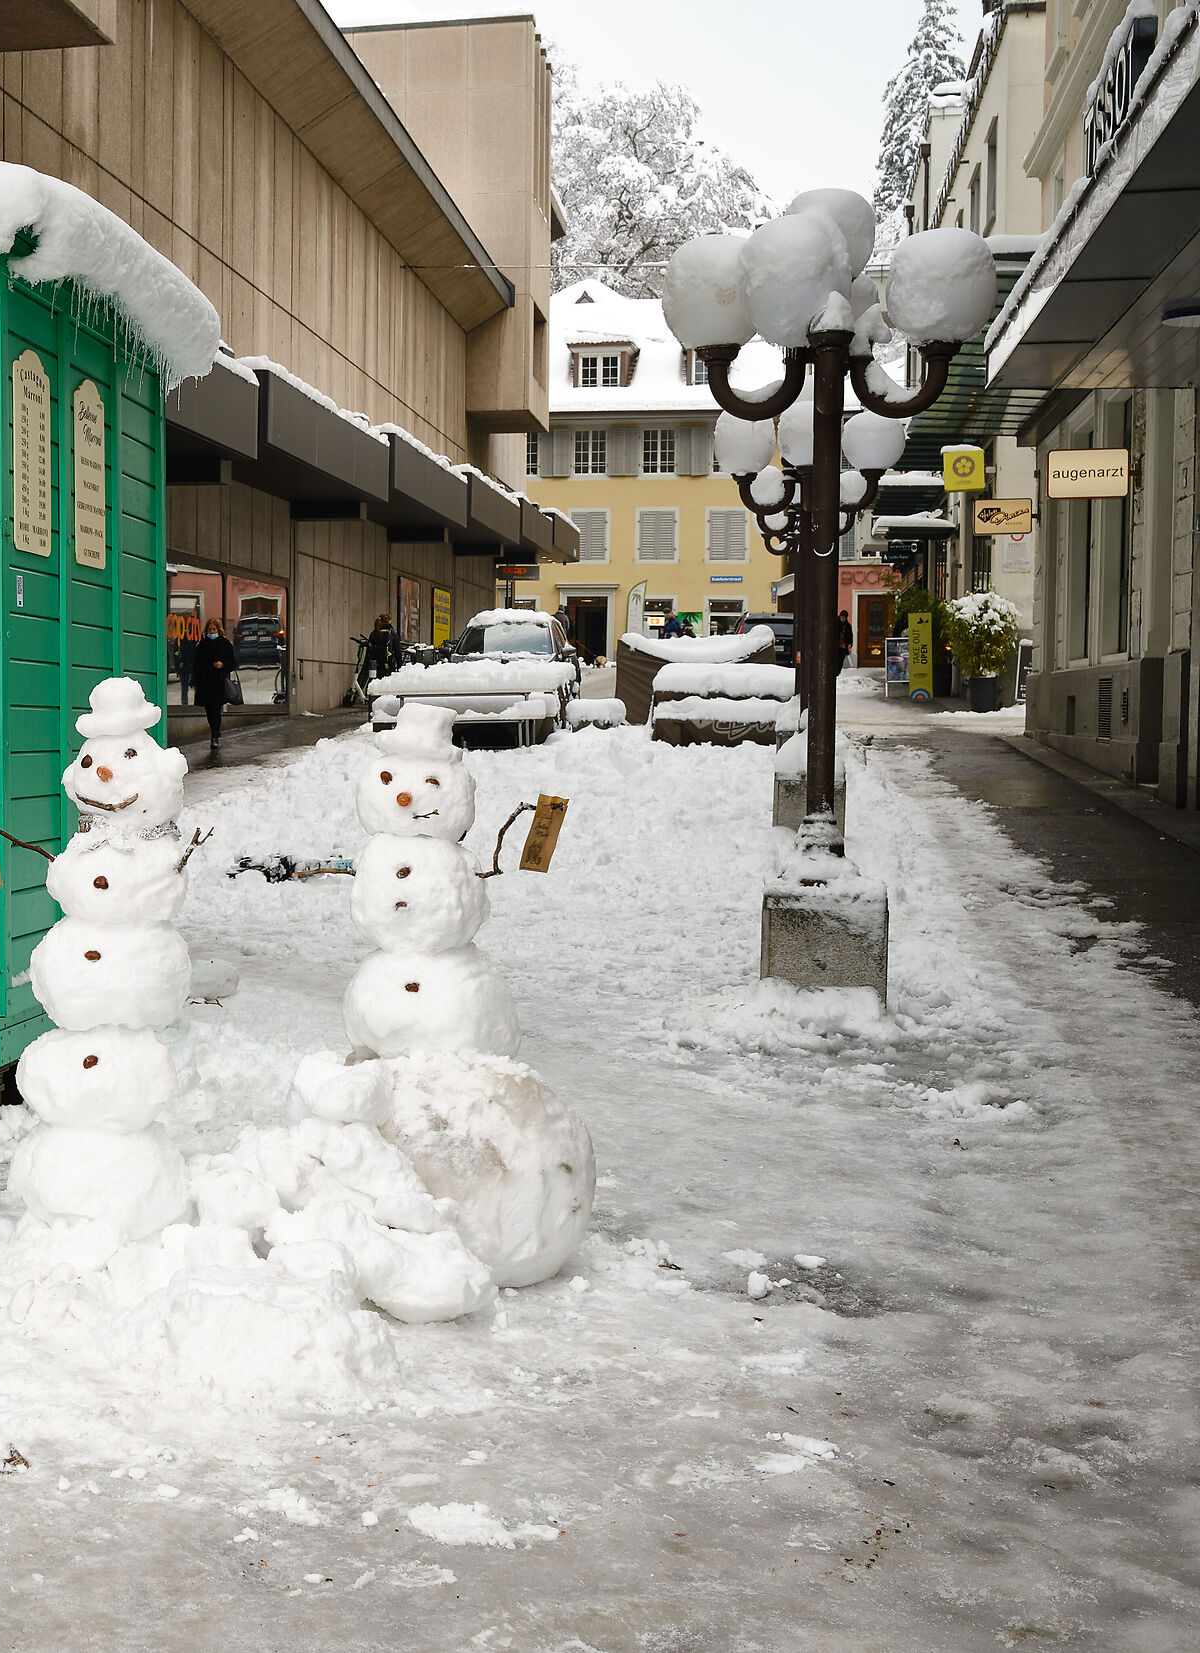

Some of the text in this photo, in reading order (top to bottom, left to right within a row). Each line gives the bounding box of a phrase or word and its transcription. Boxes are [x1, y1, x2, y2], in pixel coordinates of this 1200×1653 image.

[20, 368, 45, 393] Castagne
[23, 385, 43, 405] Marroni
[1052, 466, 1124, 481] augenarzt
